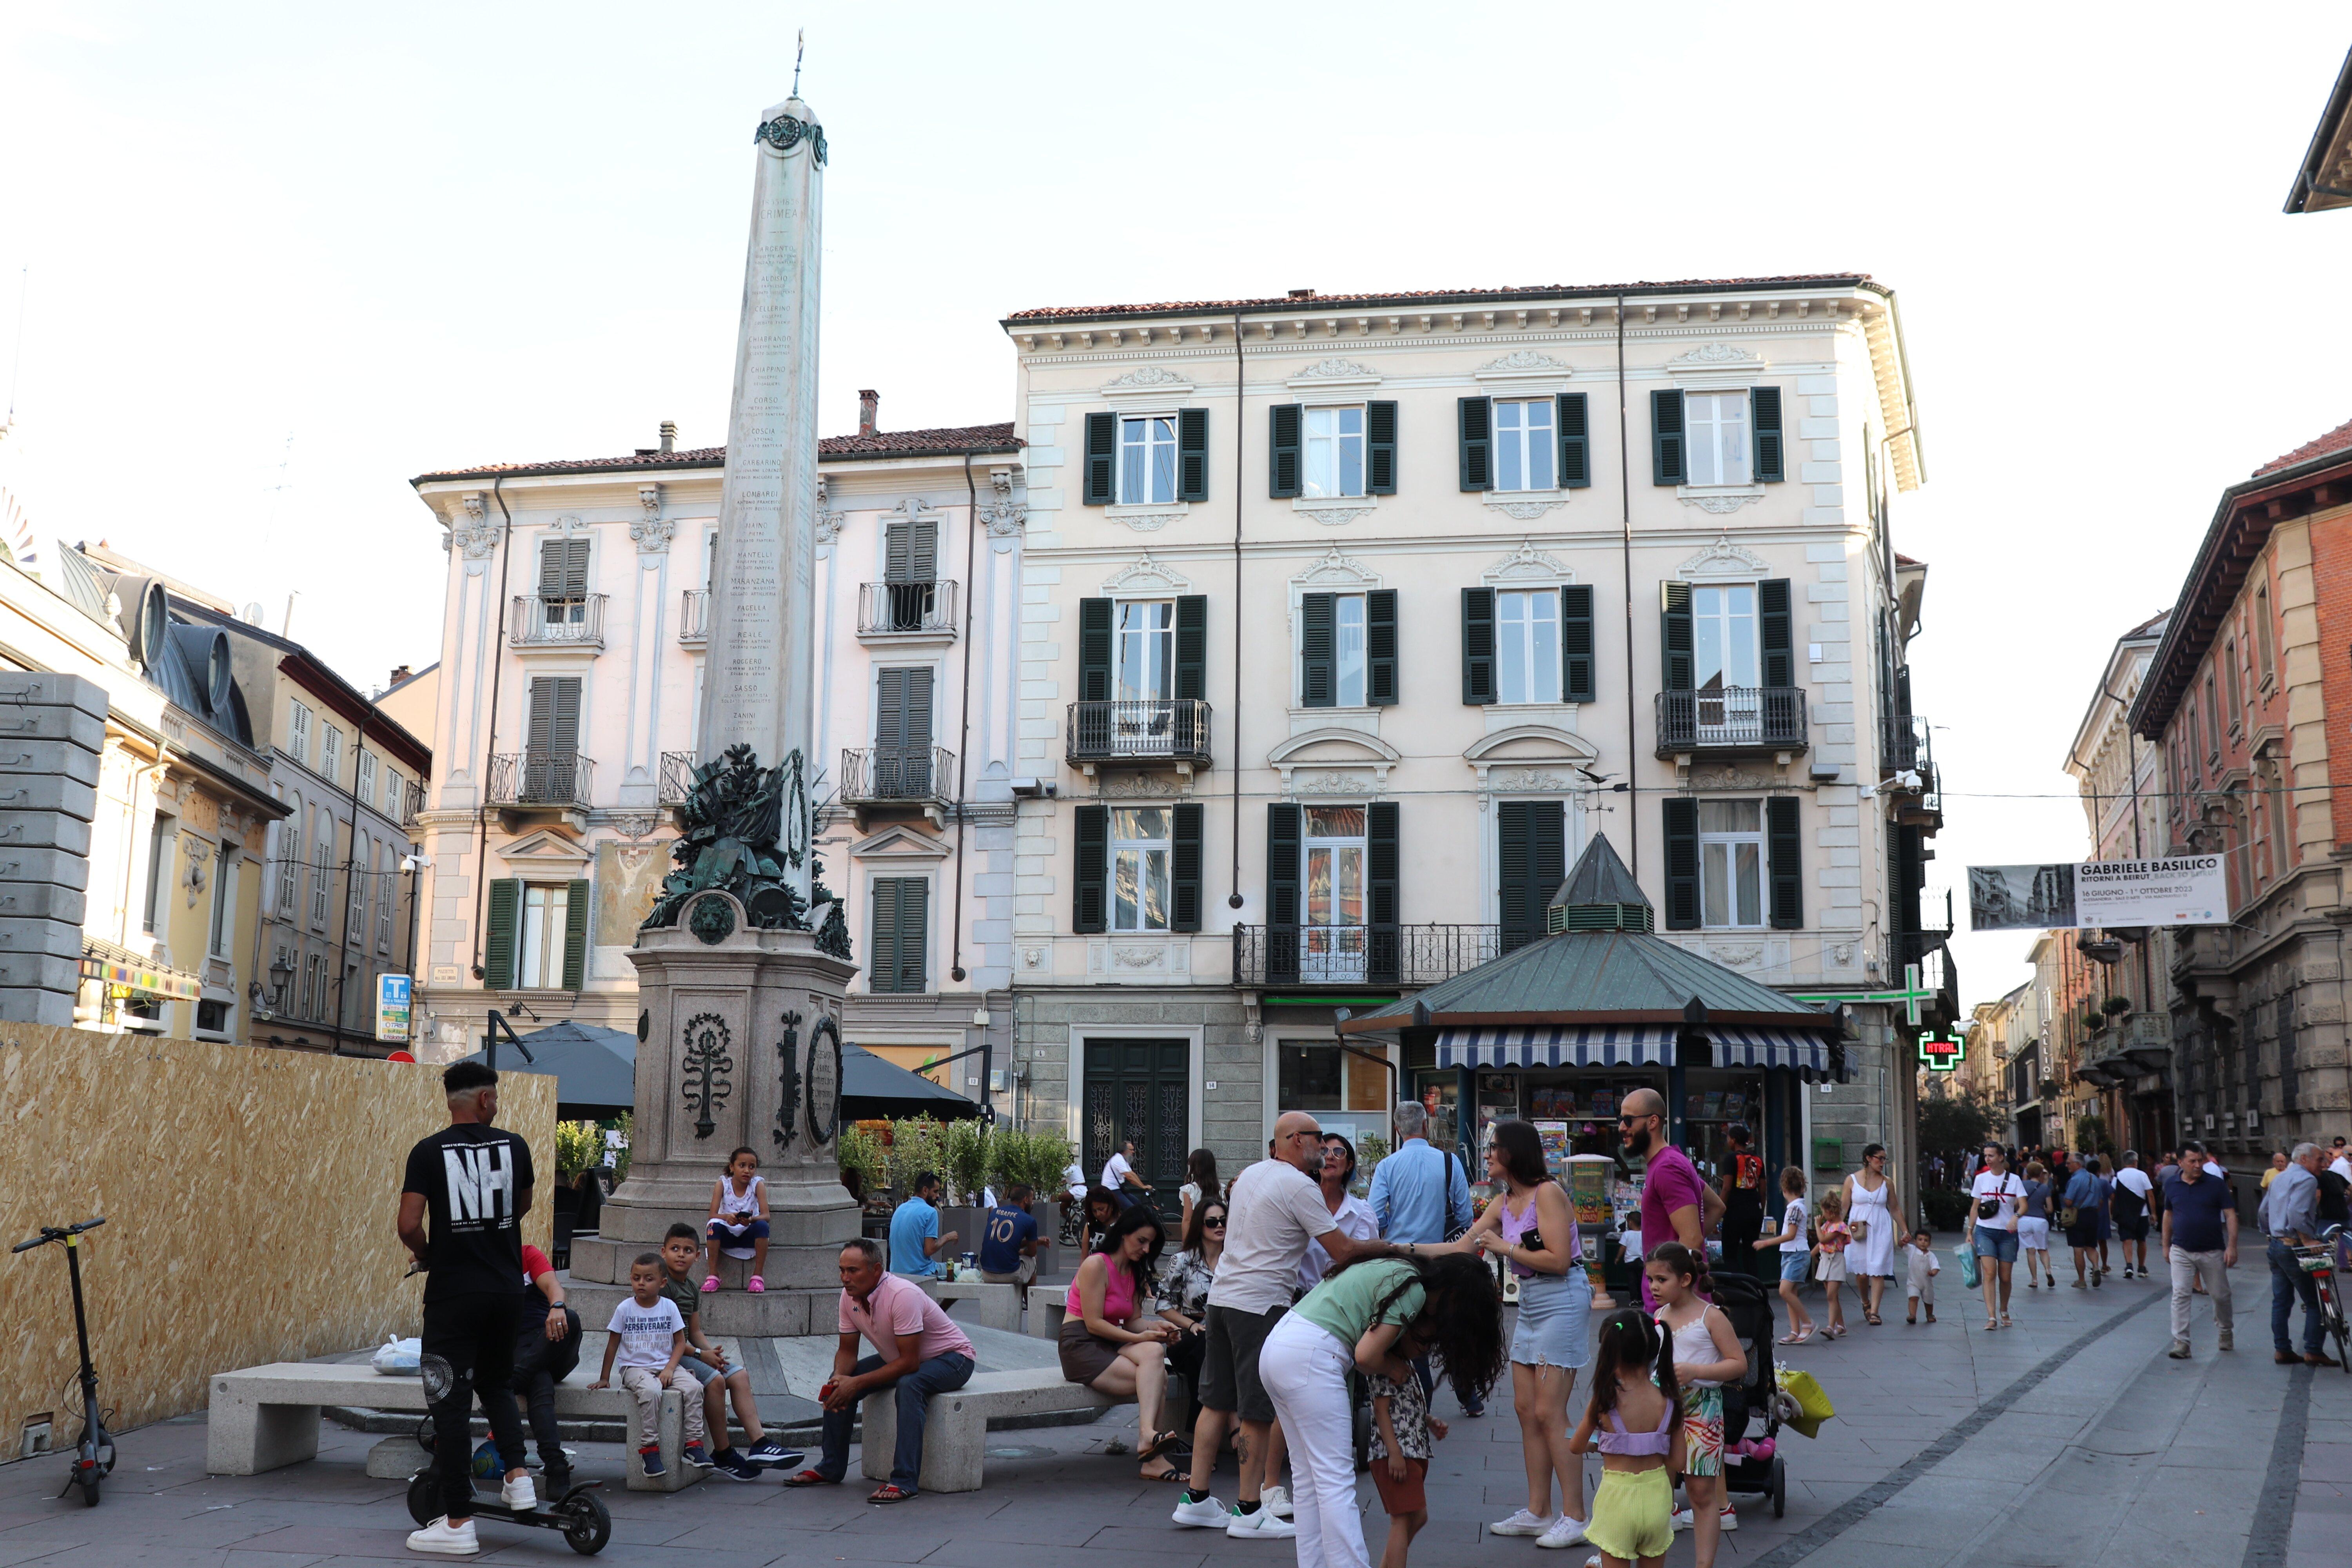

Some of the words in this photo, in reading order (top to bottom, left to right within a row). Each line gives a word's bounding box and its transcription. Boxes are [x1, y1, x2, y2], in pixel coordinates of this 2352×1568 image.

[760, 209, 797, 219] CRIMEA
[2082, 863, 2147, 875] GABRIELE
[2152, 858, 2217, 872] BASILICO
[388, 979, 405, 998] T
[443, 1145, 513, 1221] NH
[990, 1217, 1014, 1243] 10
[624, 1323, 671, 1331] PERSEVERANCE
